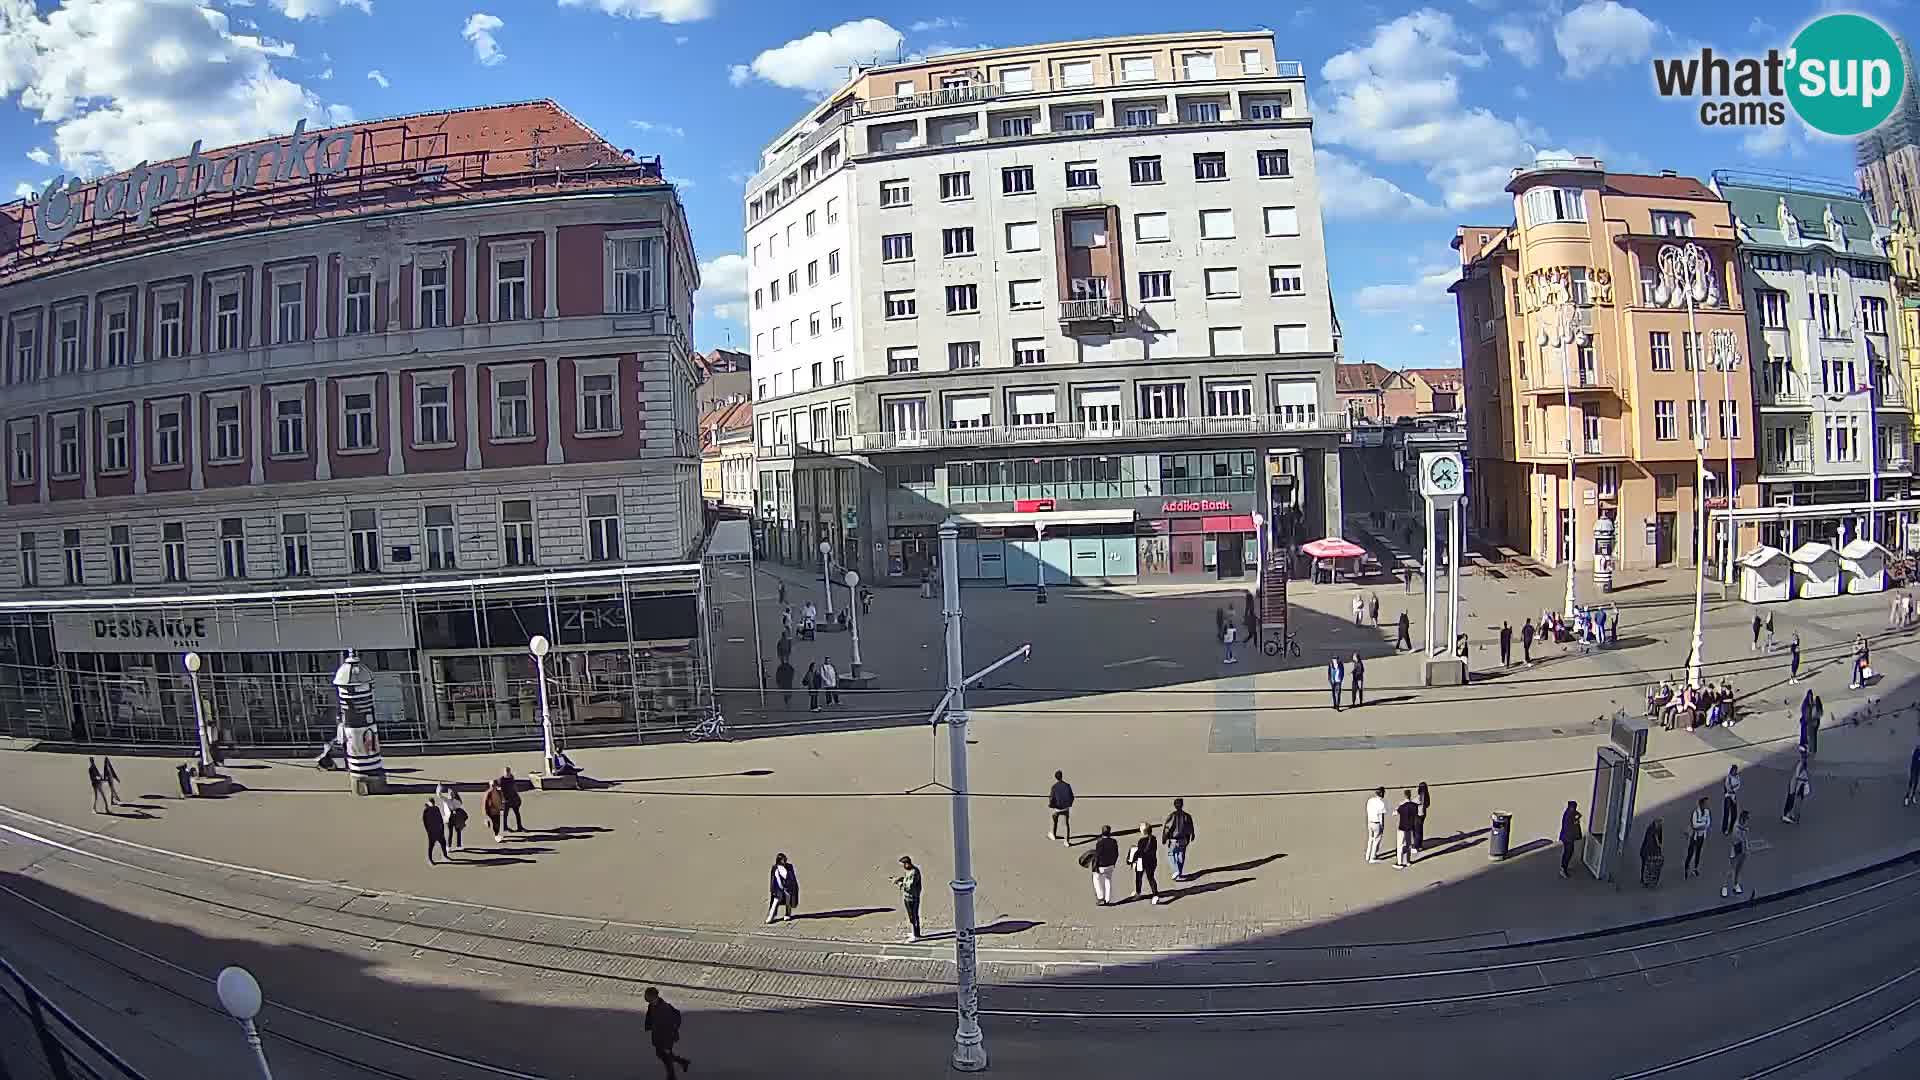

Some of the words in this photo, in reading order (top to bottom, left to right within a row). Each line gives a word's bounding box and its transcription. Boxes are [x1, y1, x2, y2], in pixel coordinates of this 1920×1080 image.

[1161, 501, 1201, 513] Addiko
[1201, 500, 1231, 511] Bank
[95, 617, 207, 638] DESSANGE
